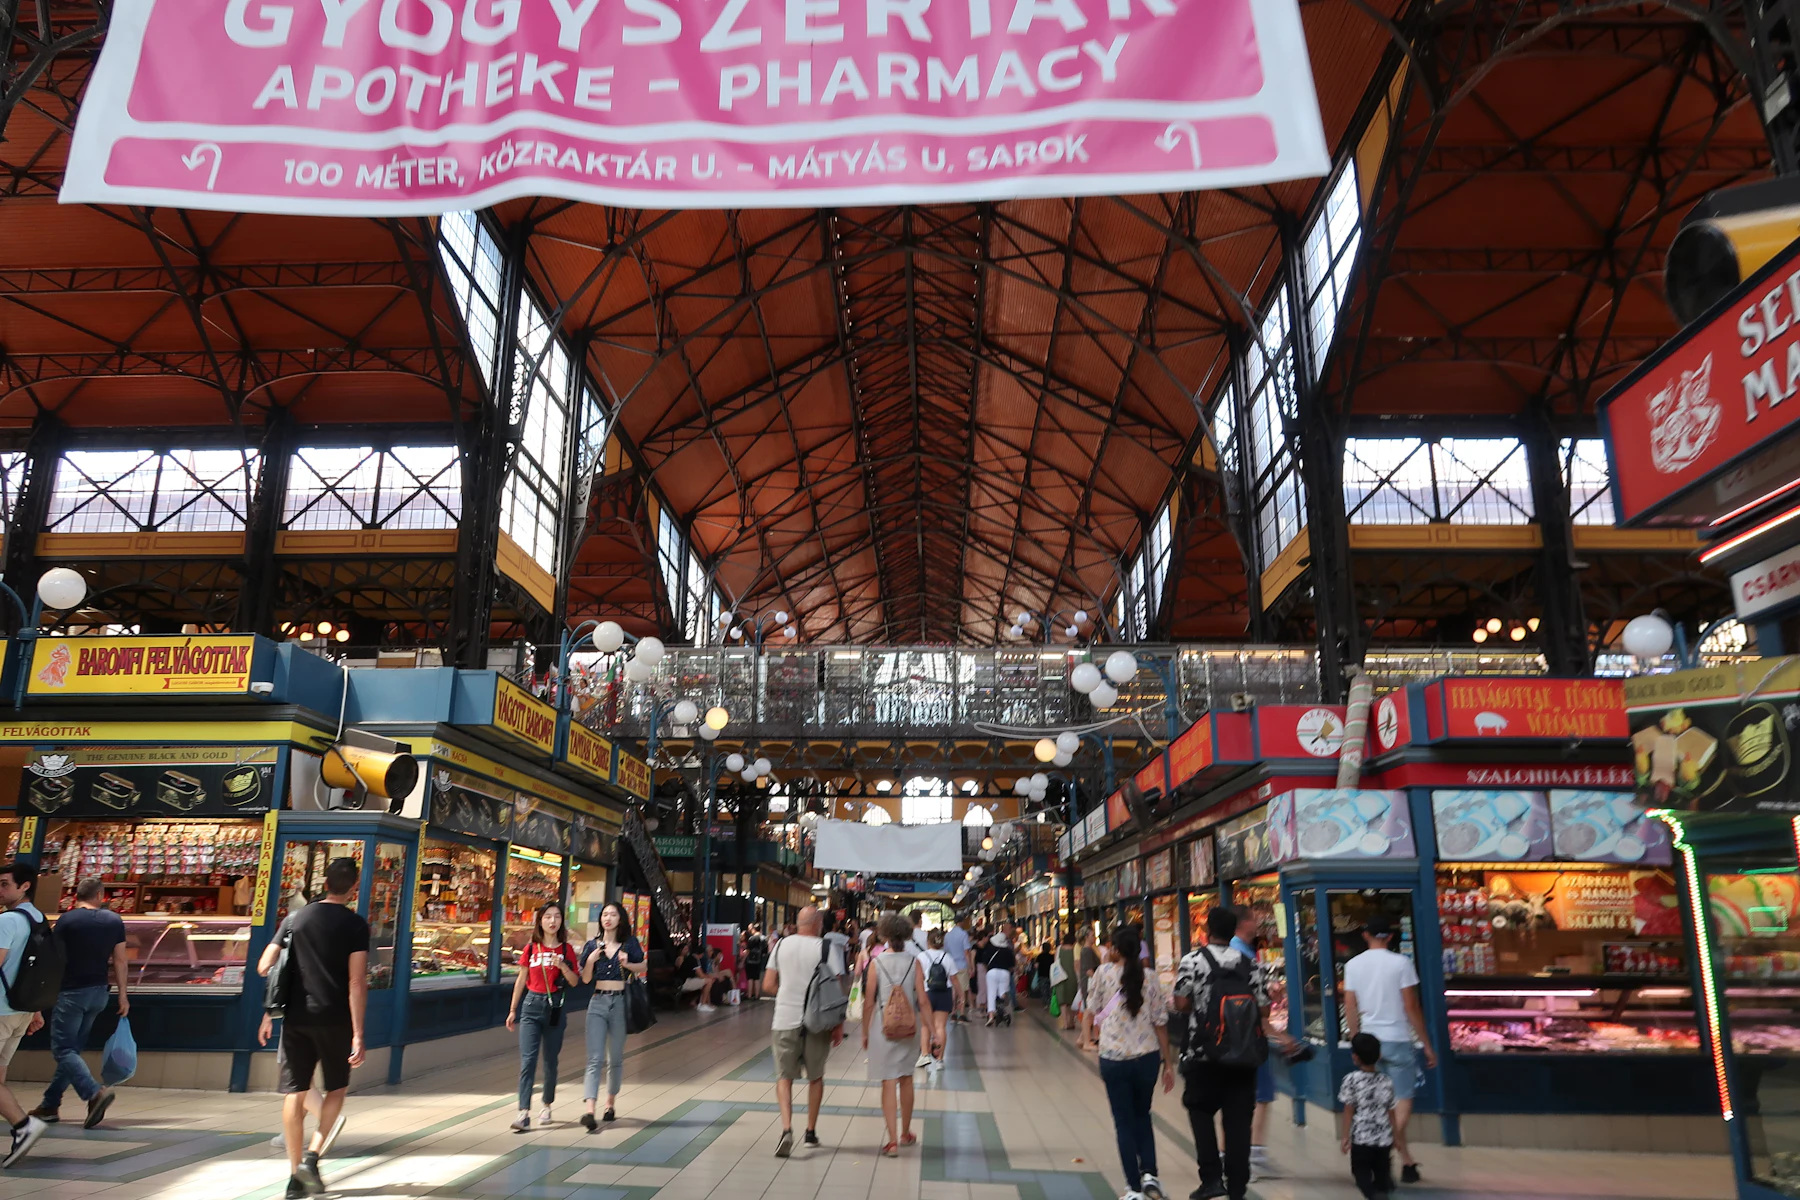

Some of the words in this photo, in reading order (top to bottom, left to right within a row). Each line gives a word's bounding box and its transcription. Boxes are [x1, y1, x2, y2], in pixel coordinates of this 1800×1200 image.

[252, 52, 615, 116] APOTHEKE
[718, 33, 1131, 111] PHARMACY
[284, 159, 344, 185] 100
[355, 156, 466, 191] MÉTER,
[478, 139, 678, 182] KÖZRAKTÁR
[691, 152, 723, 178] U.
[768, 139, 908, 181] MÁTYÁS
[967, 134, 1092, 172] SAROK
[144, 638, 249, 675] FELVÁGOTTAK
[2, 724, 91, 736] FELVÁGOTTAK
[86, 753, 104, 761] THE
[107, 752, 145, 761] GENUINE
[148, 751, 176, 760] BLACK
[179, 751, 200, 760] AND
[203, 750, 229, 760] GOLD
